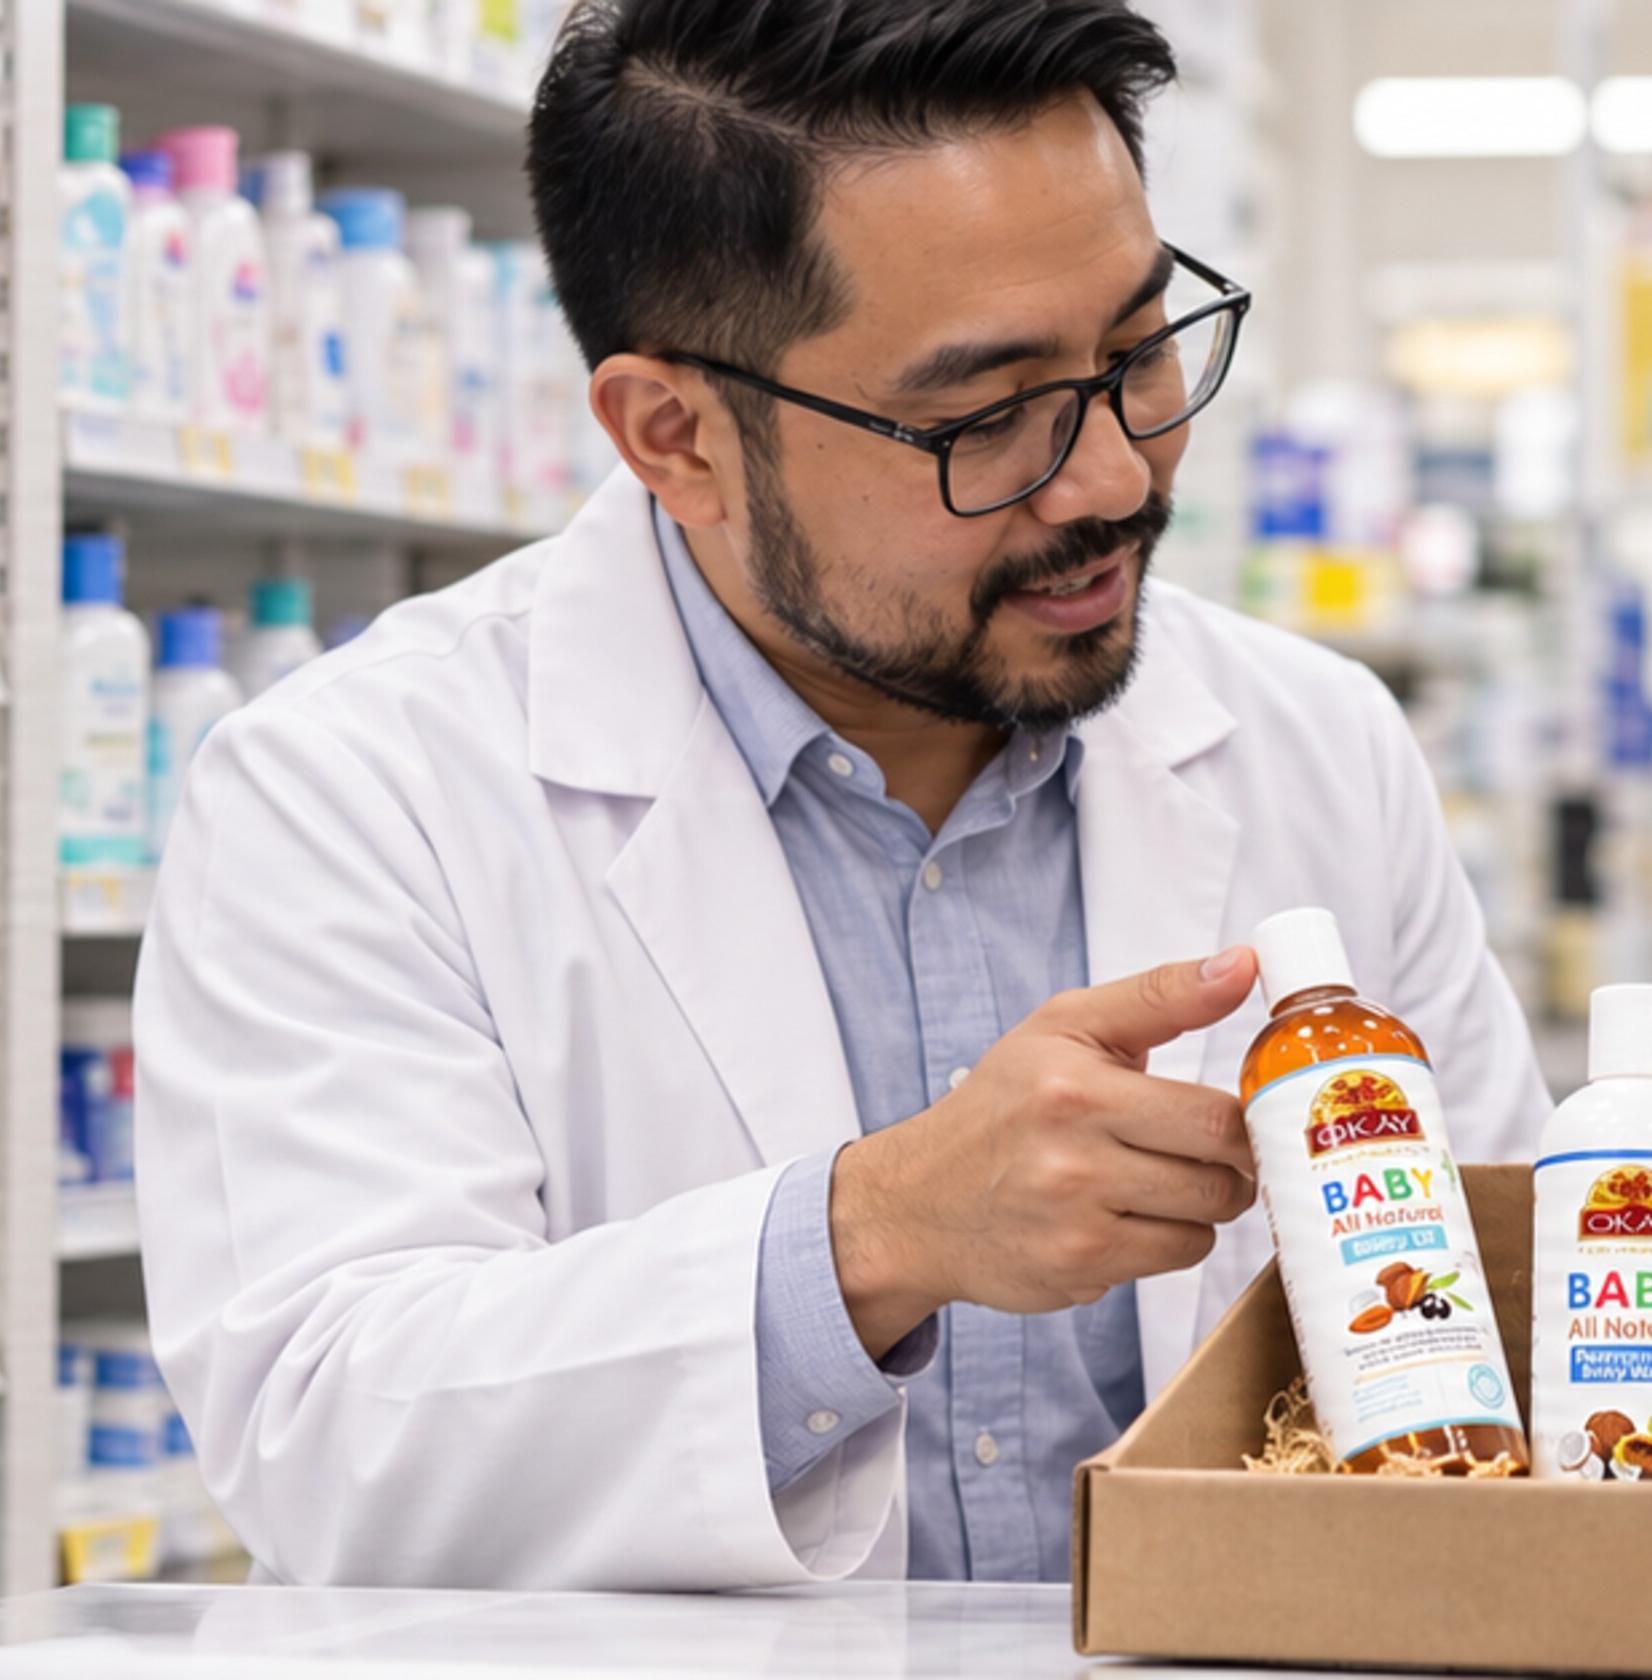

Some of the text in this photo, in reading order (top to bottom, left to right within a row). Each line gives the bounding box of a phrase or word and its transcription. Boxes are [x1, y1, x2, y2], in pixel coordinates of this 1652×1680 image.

[1317, 1114, 1412, 1147] OKAY
[1322, 1168, 1433, 1214] BABY
[1331, 1214, 1361, 1237] All
[1568, 1317, 1597, 1340] All
